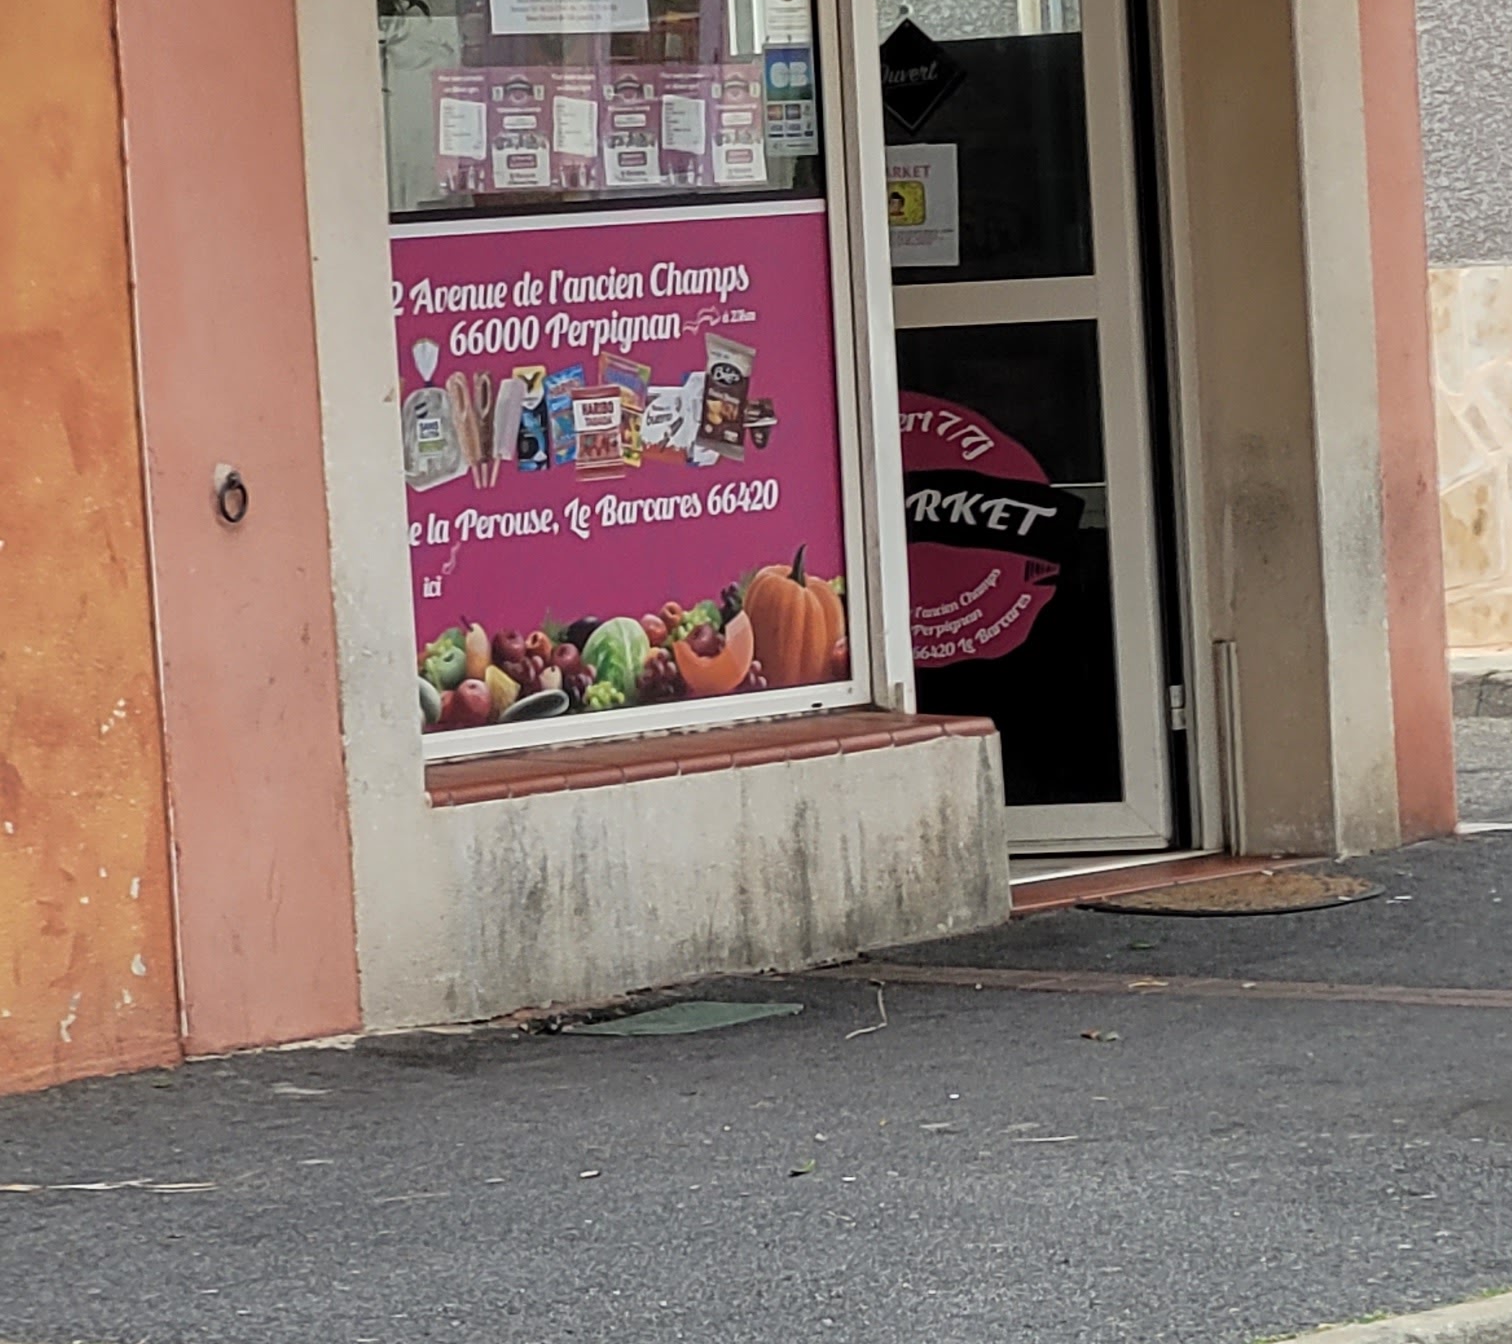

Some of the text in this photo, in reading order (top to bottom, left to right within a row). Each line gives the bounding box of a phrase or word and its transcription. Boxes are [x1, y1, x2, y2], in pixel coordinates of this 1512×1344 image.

[769, 61, 809, 88] CB
[409, 277, 508, 315] Avenue
[513, 271, 544, 307] de
[550, 266, 644, 304] l'ancien
[650, 262, 750, 303] Champs
[450, 309, 681, 356] 66000 Perpignan
[427, 513, 449, 545] la
[455, 508, 559, 541] Perouse,
[564, 497, 591, 539] Le
[595, 492, 702, 527] Barcares
[707, 478, 779, 516] 66420
[906, 488, 1057, 536] RKET
[423, 575, 442, 598] ici
[959, 568, 1001, 607] Champs
[911, 608, 984, 638] Perpignan
[975, 593, 1032, 644] Barcares
